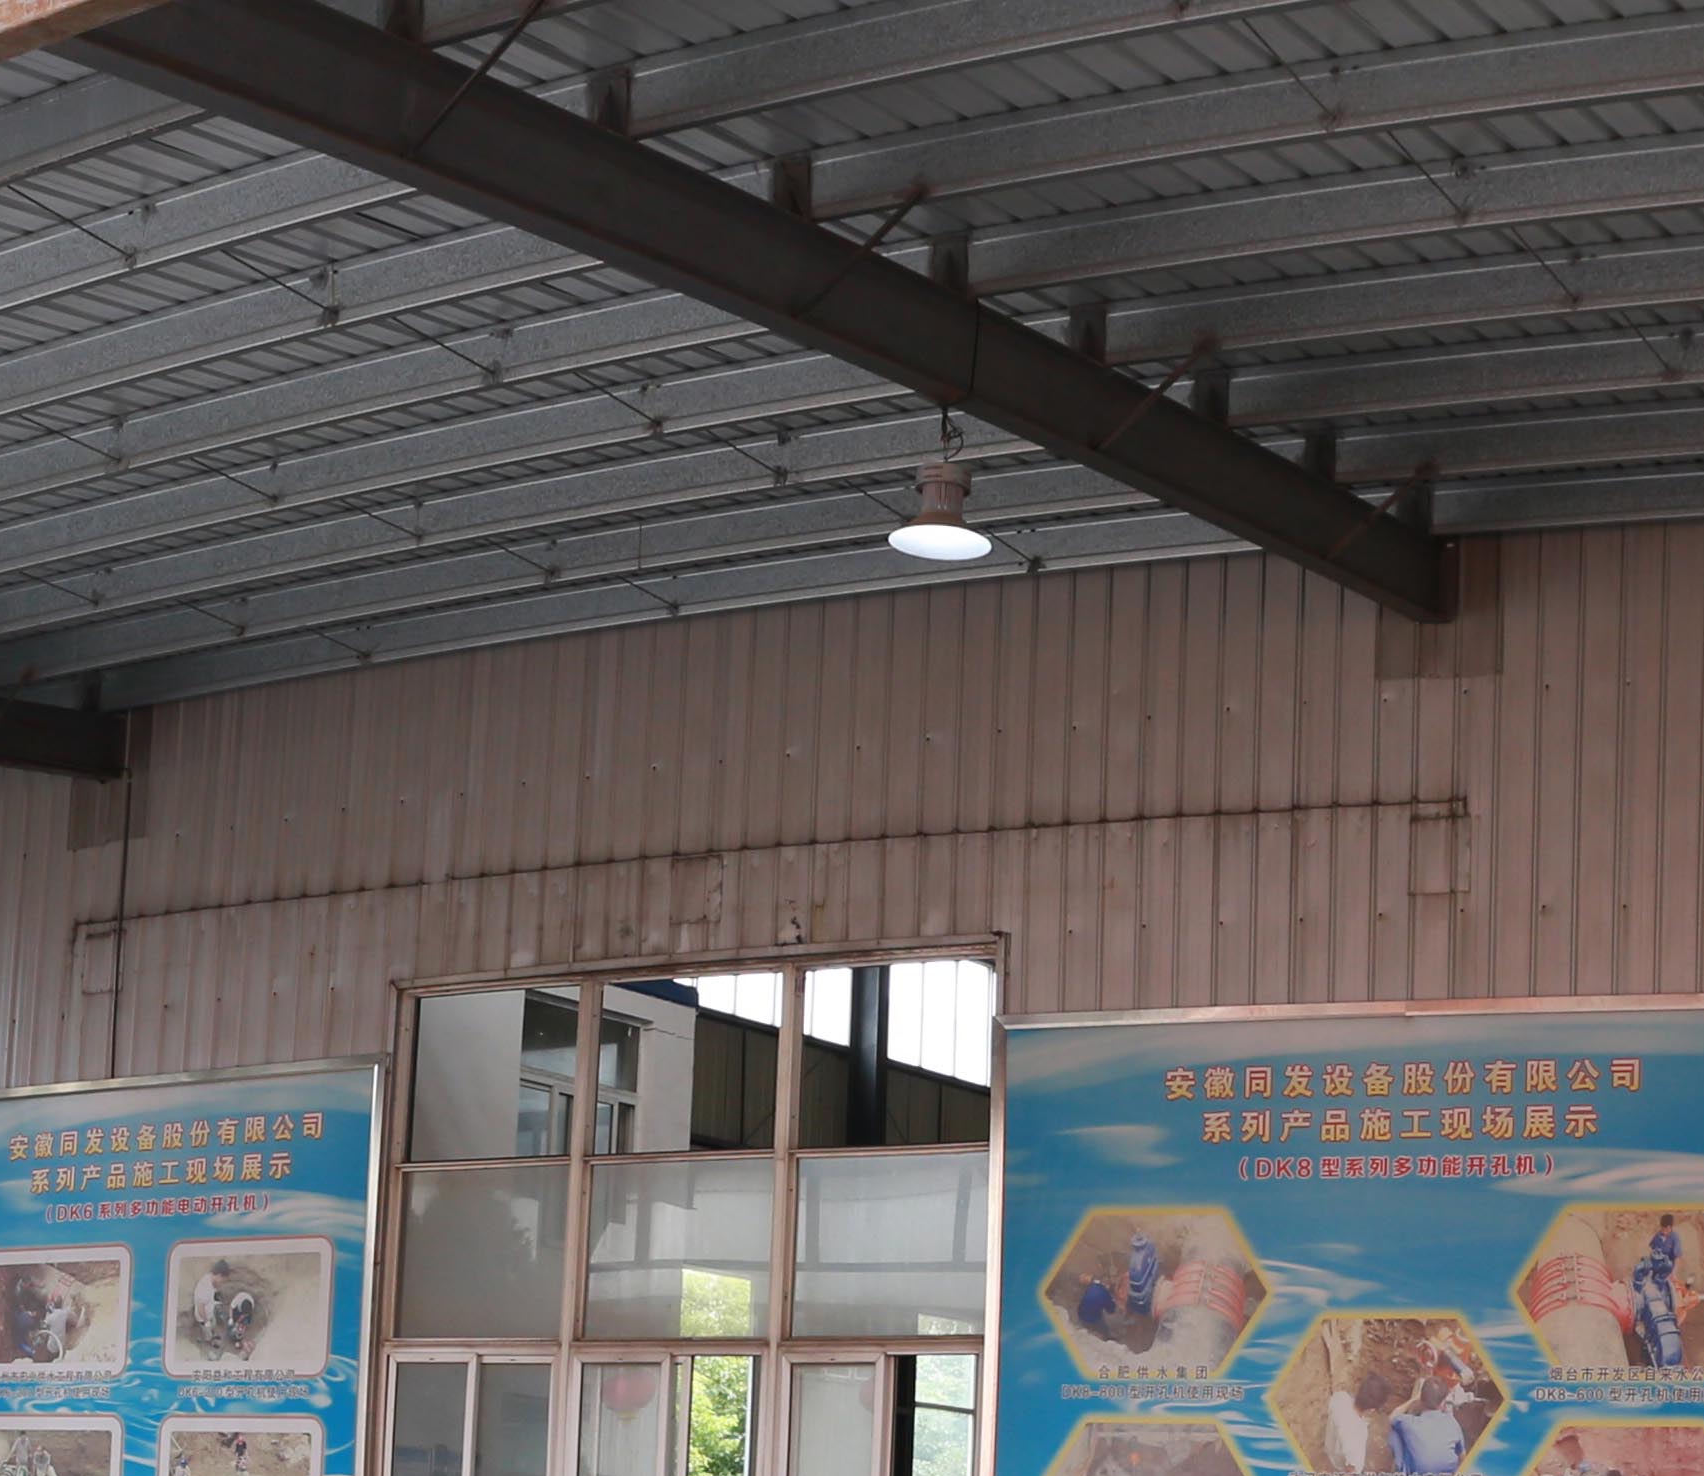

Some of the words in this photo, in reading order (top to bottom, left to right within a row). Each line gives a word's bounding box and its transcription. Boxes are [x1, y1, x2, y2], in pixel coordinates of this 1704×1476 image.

[1163, 1058, 1642, 1100] 安徽同发设备股份有限公司
[8, 1111, 325, 1161] 安徽同发设备股份有限公司
[1200, 1105, 1600, 1144] 系列产品施工现场展示
[29, 1151, 292, 1194] 系列产品施工现场展示
[1098, 1366, 1208, 1380] 合肥供水集团
[1129, 1384, 1244, 1400] 型开孔机使用现场
